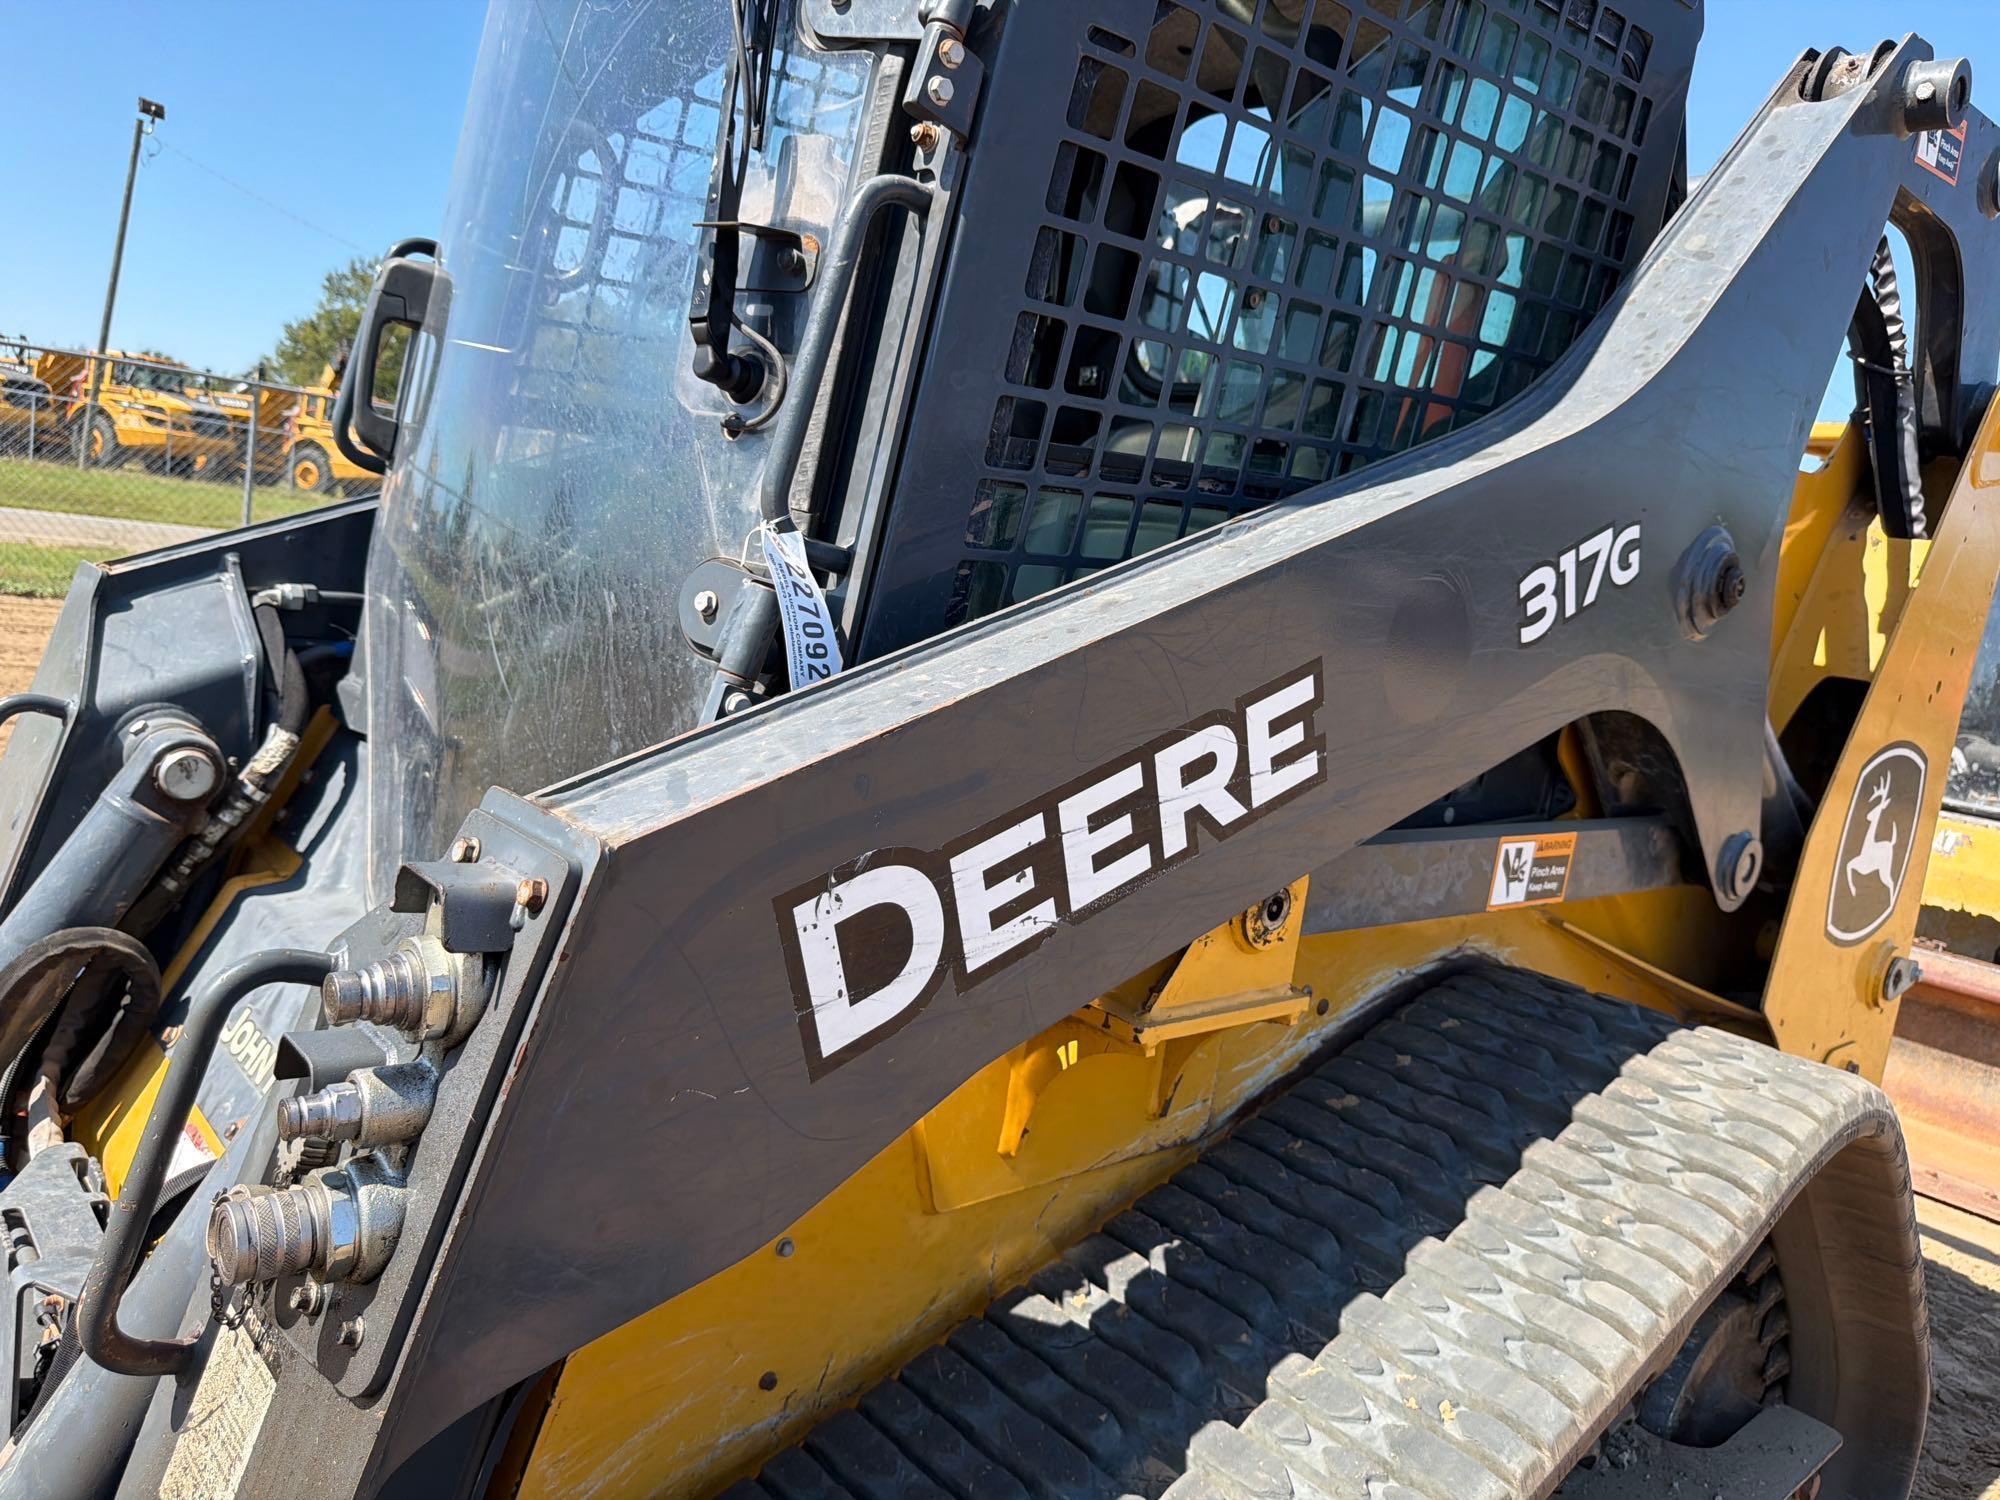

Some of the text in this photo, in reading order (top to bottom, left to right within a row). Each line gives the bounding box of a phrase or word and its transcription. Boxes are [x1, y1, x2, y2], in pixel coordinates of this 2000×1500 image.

[778, 563, 790, 590] REBEL
[787, 592, 800, 631] AUCTION
[795, 633, 805, 677] COMPANY
[784, 561, 832, 680] 227092
[1519, 524, 1641, 644] 317G
[792, 674, 1319, 1059] DEERE
[1528, 881, 1559, 892] Keep Away
[1531, 865, 1566, 877] Pinch Area
[221, 1007, 278, 1095] JOHN
